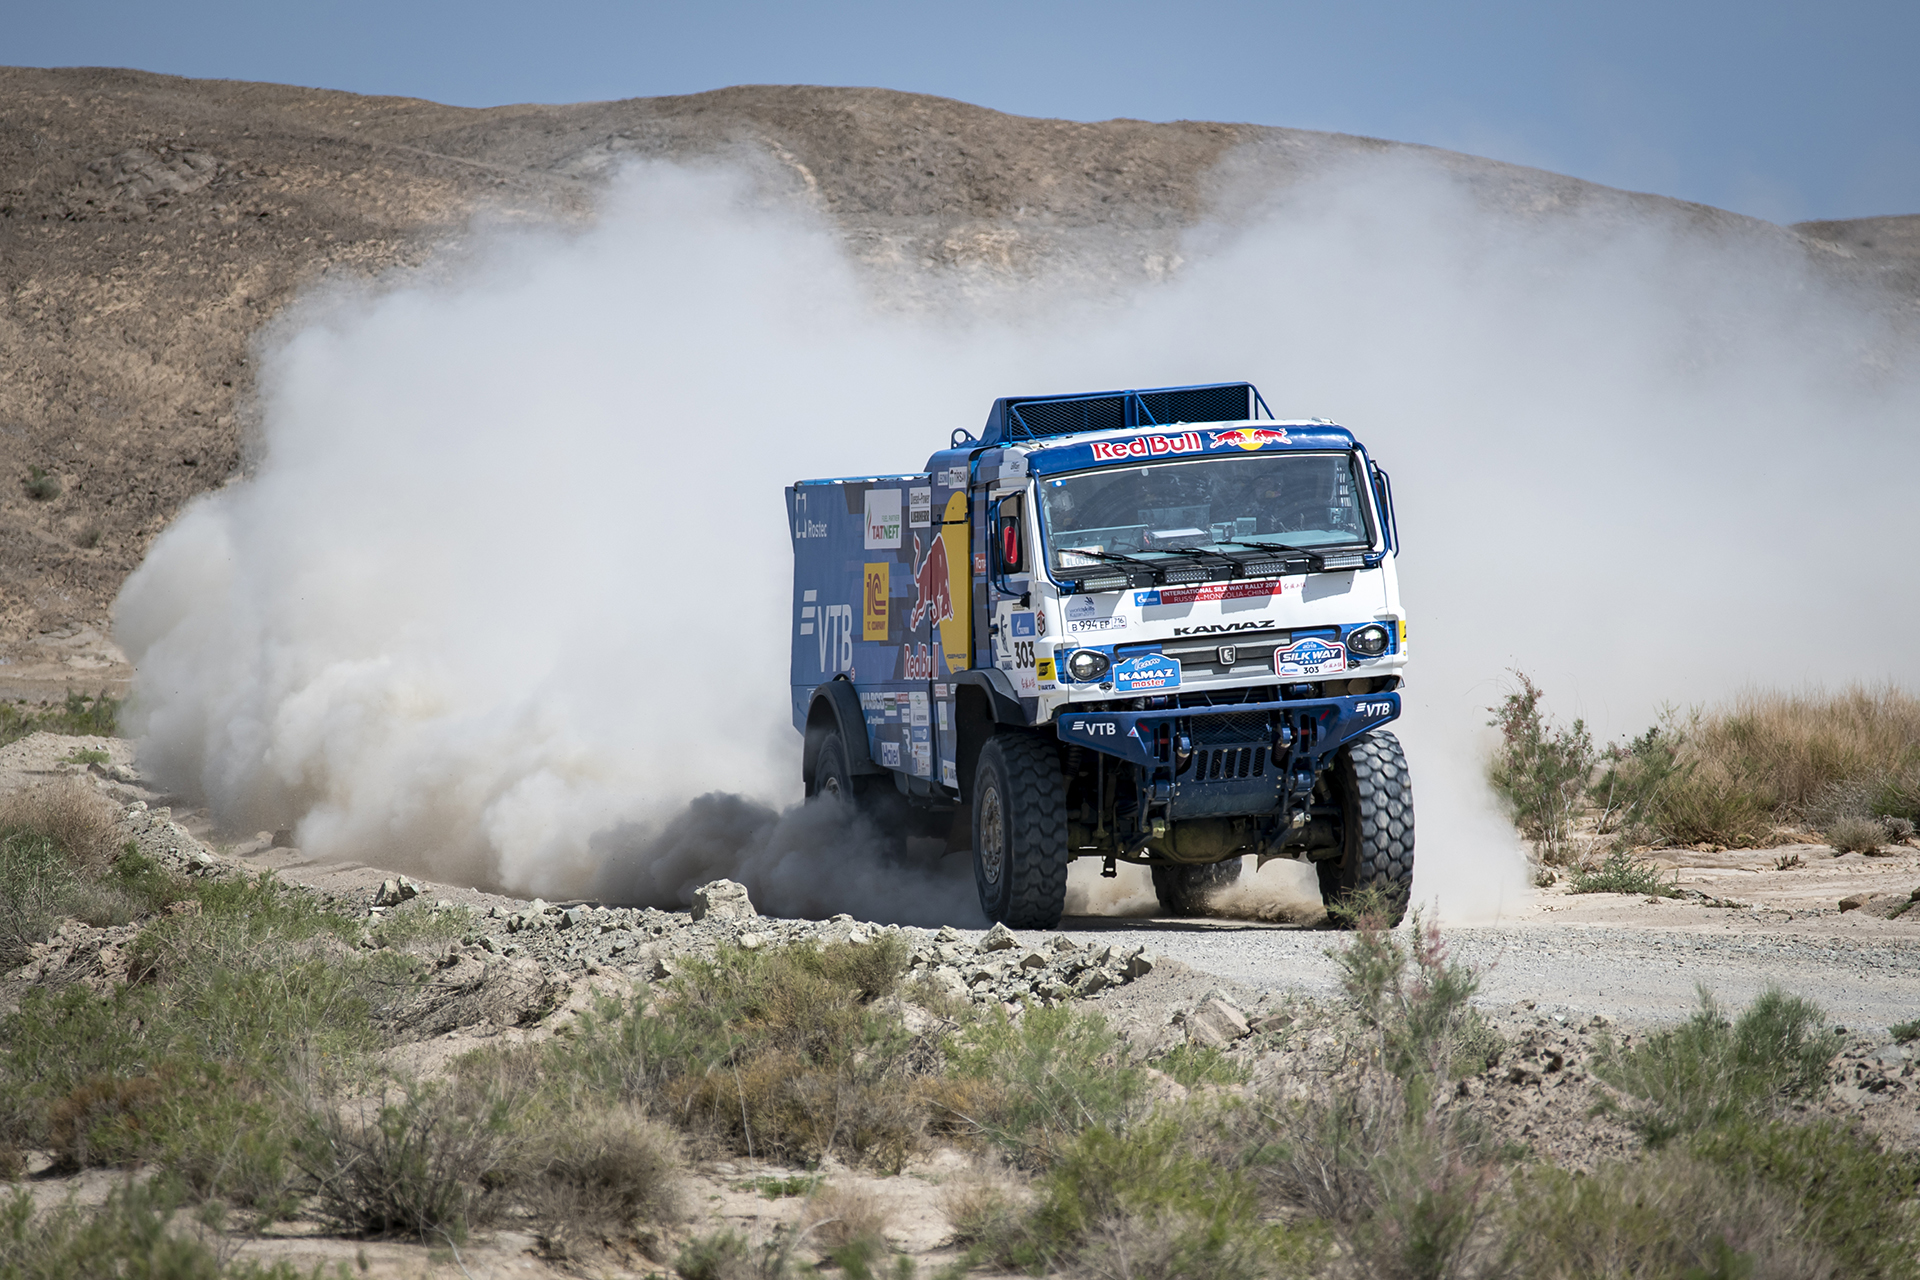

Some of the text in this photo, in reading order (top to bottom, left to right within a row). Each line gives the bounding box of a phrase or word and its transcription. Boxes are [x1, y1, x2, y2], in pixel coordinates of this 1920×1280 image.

[1091, 432, 1203, 461] Red Bull
[808, 520, 827, 537] Rostec
[872, 524, 900, 540] TATNEFT
[1162, 587, 1212, 596] INTERNATIONAL
[1173, 620, 1275, 636] KAMAZ
[817, 604, 853, 672] VTB
[904, 642, 939, 680] Red Bull
[1014, 641, 1035, 669] 303
[1282, 650, 1338, 662] SILK WAY
[1132, 658, 1160, 670] Team
[1304, 666, 1319, 674] 303
[1118, 668, 1174, 680] KAMAZ
[1132, 678, 1165, 688] master
[1366, 702, 1390, 716] VTB
[1086, 722, 1116, 736] VTB
